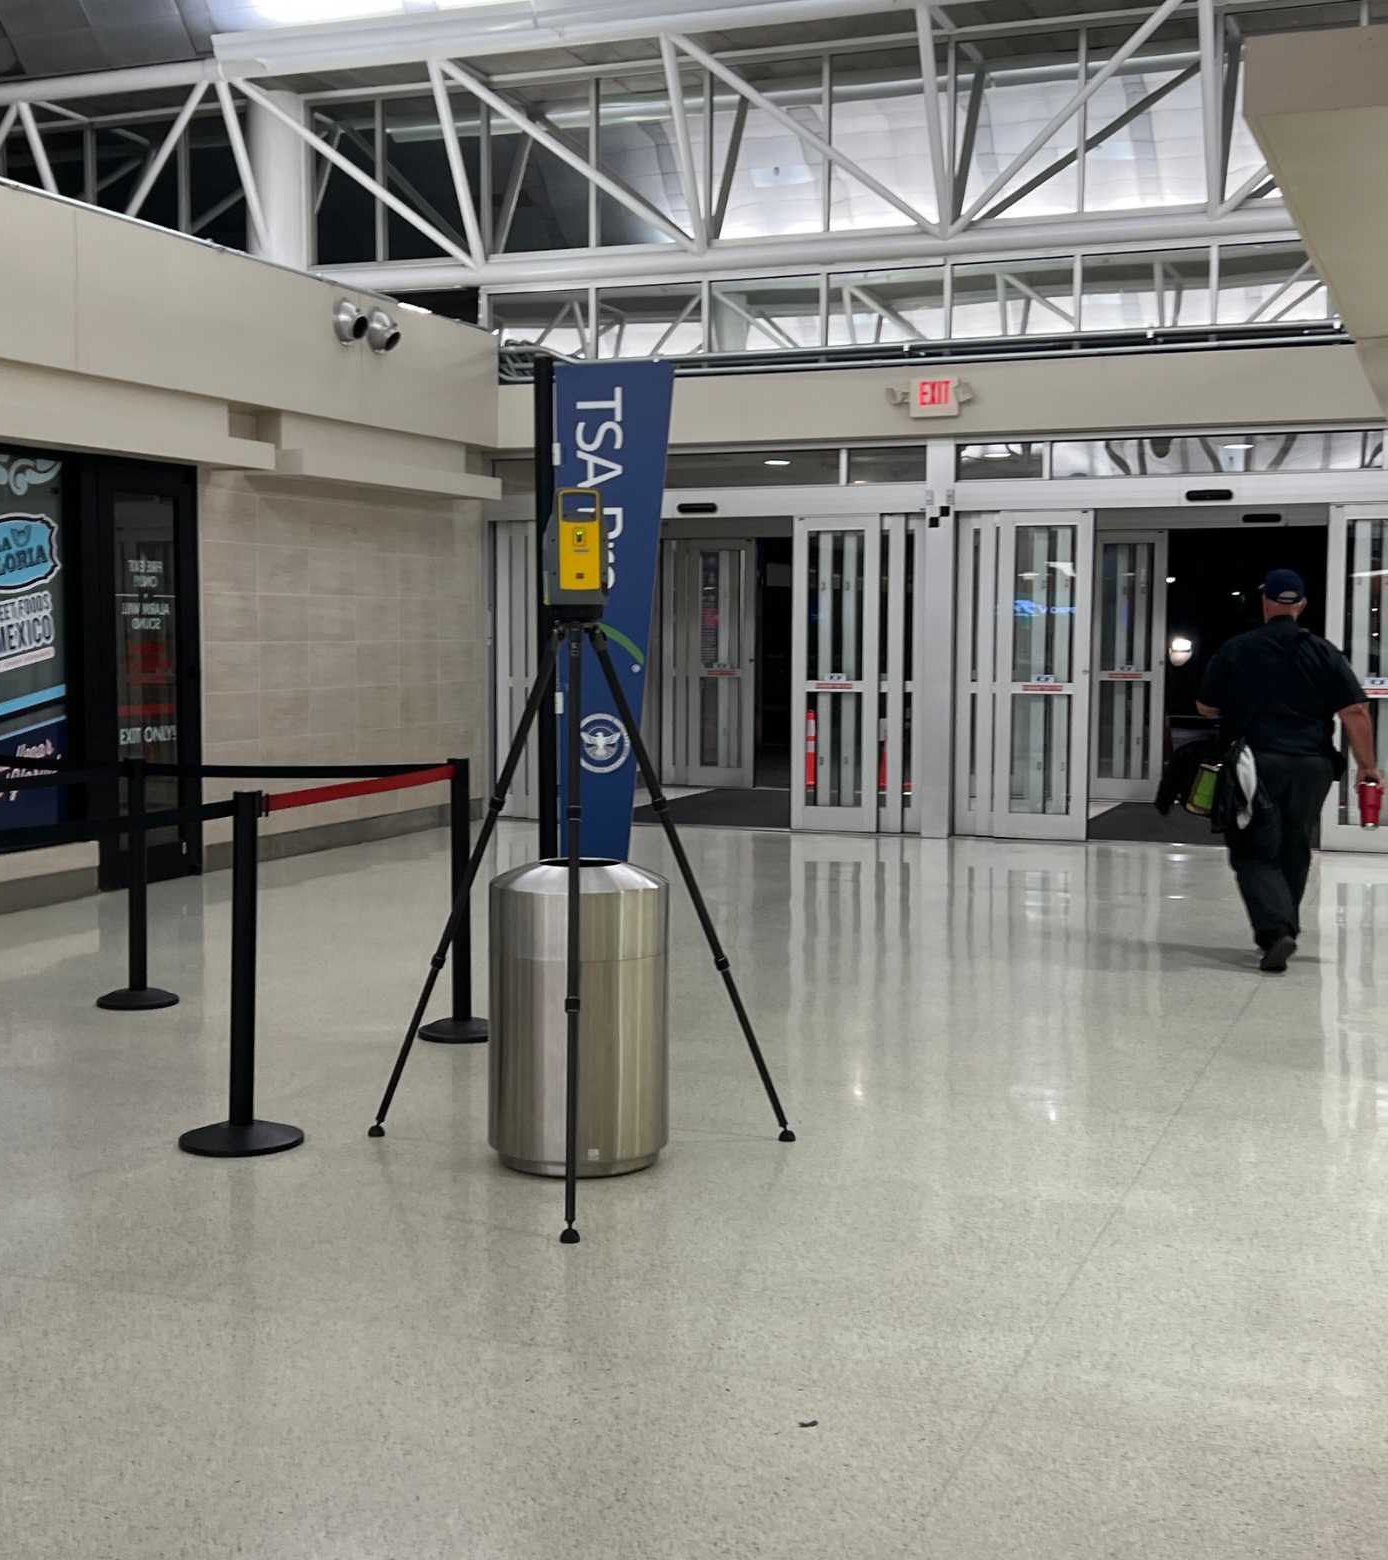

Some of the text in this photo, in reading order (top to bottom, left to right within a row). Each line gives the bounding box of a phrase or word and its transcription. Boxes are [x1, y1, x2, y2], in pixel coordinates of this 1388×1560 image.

[919, 381, 950, 405] EXIT
[576, 387, 623, 487] TSA
[18, 593, 50, 618] FOODS
[120, 728, 141, 745] EXIT
